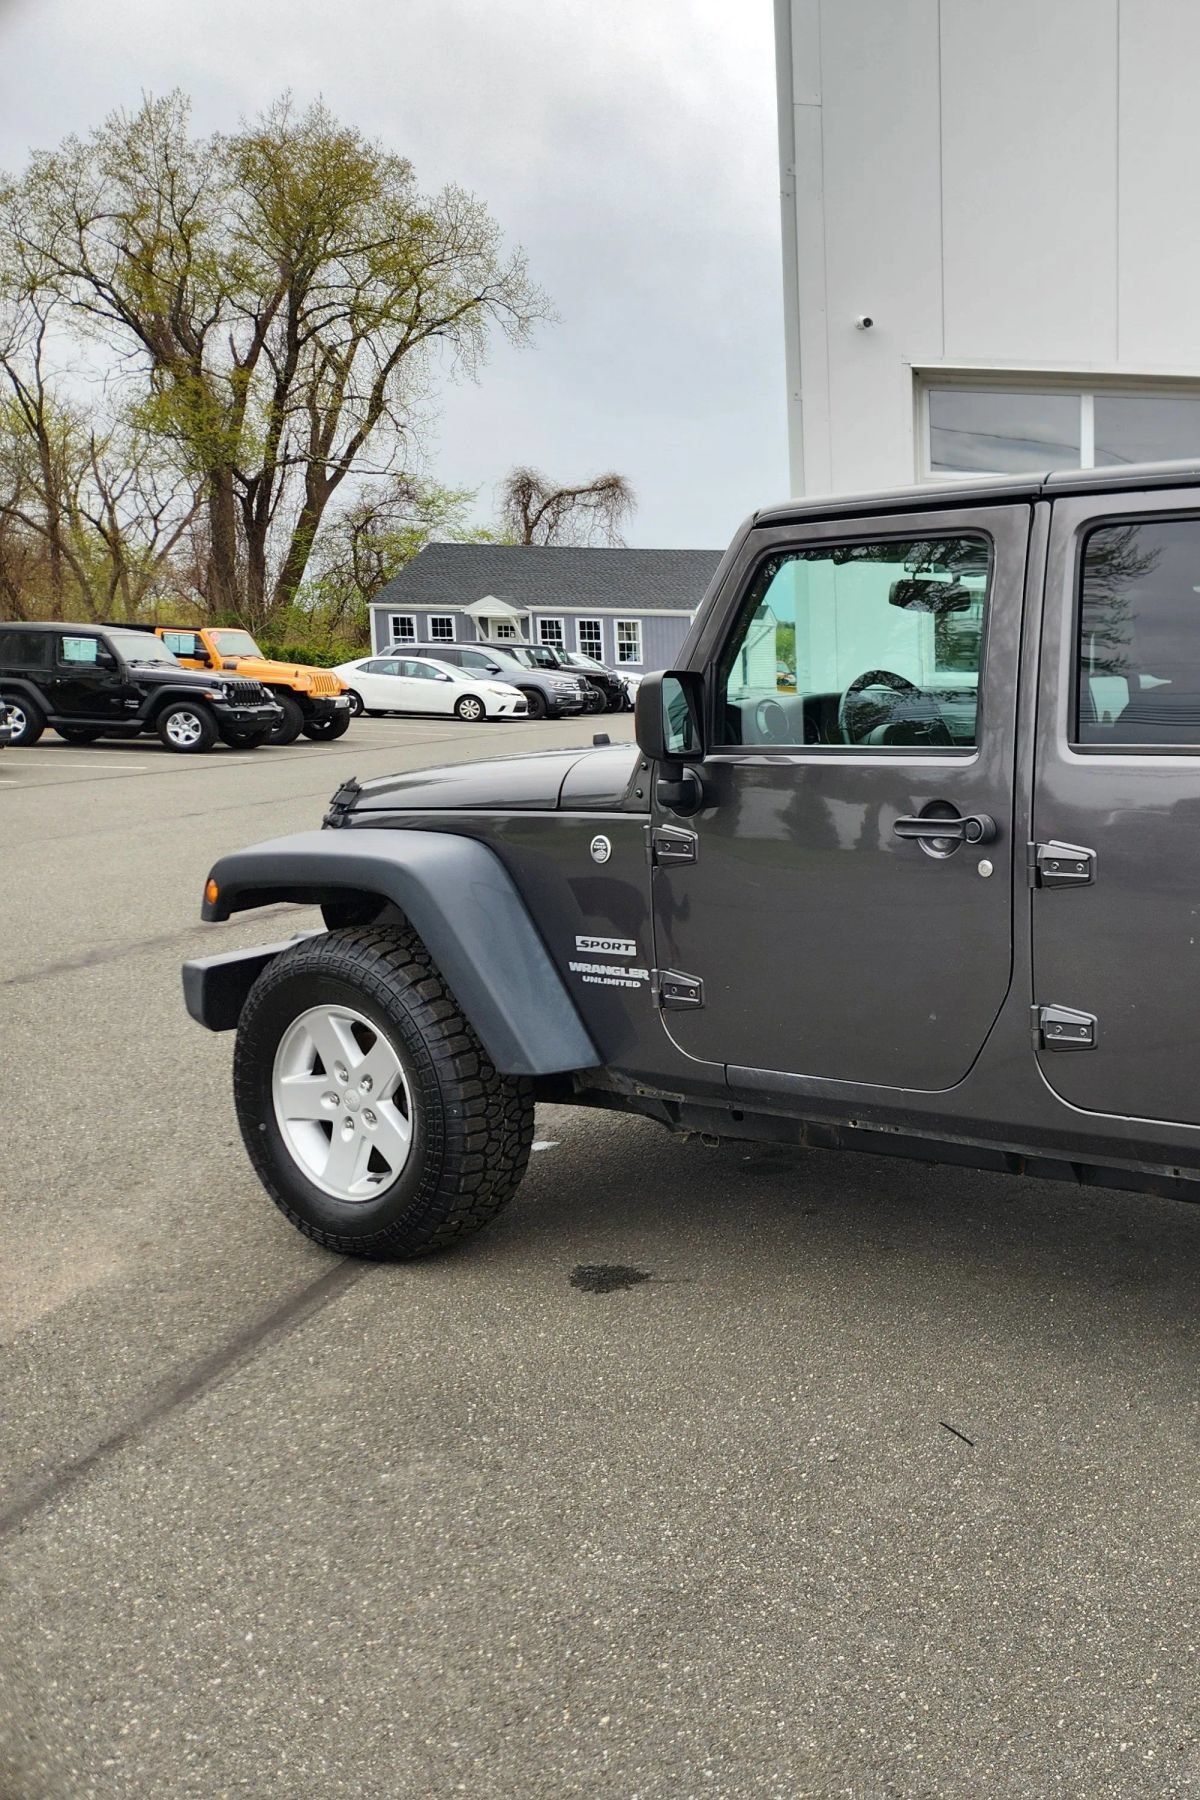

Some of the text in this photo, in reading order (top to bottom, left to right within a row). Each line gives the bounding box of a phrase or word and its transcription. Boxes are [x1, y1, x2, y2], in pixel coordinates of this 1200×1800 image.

[579, 939, 632, 952] SPORT
[568, 961, 650, 980] WRANGLER
[582, 975, 641, 988] UNLIMITED
